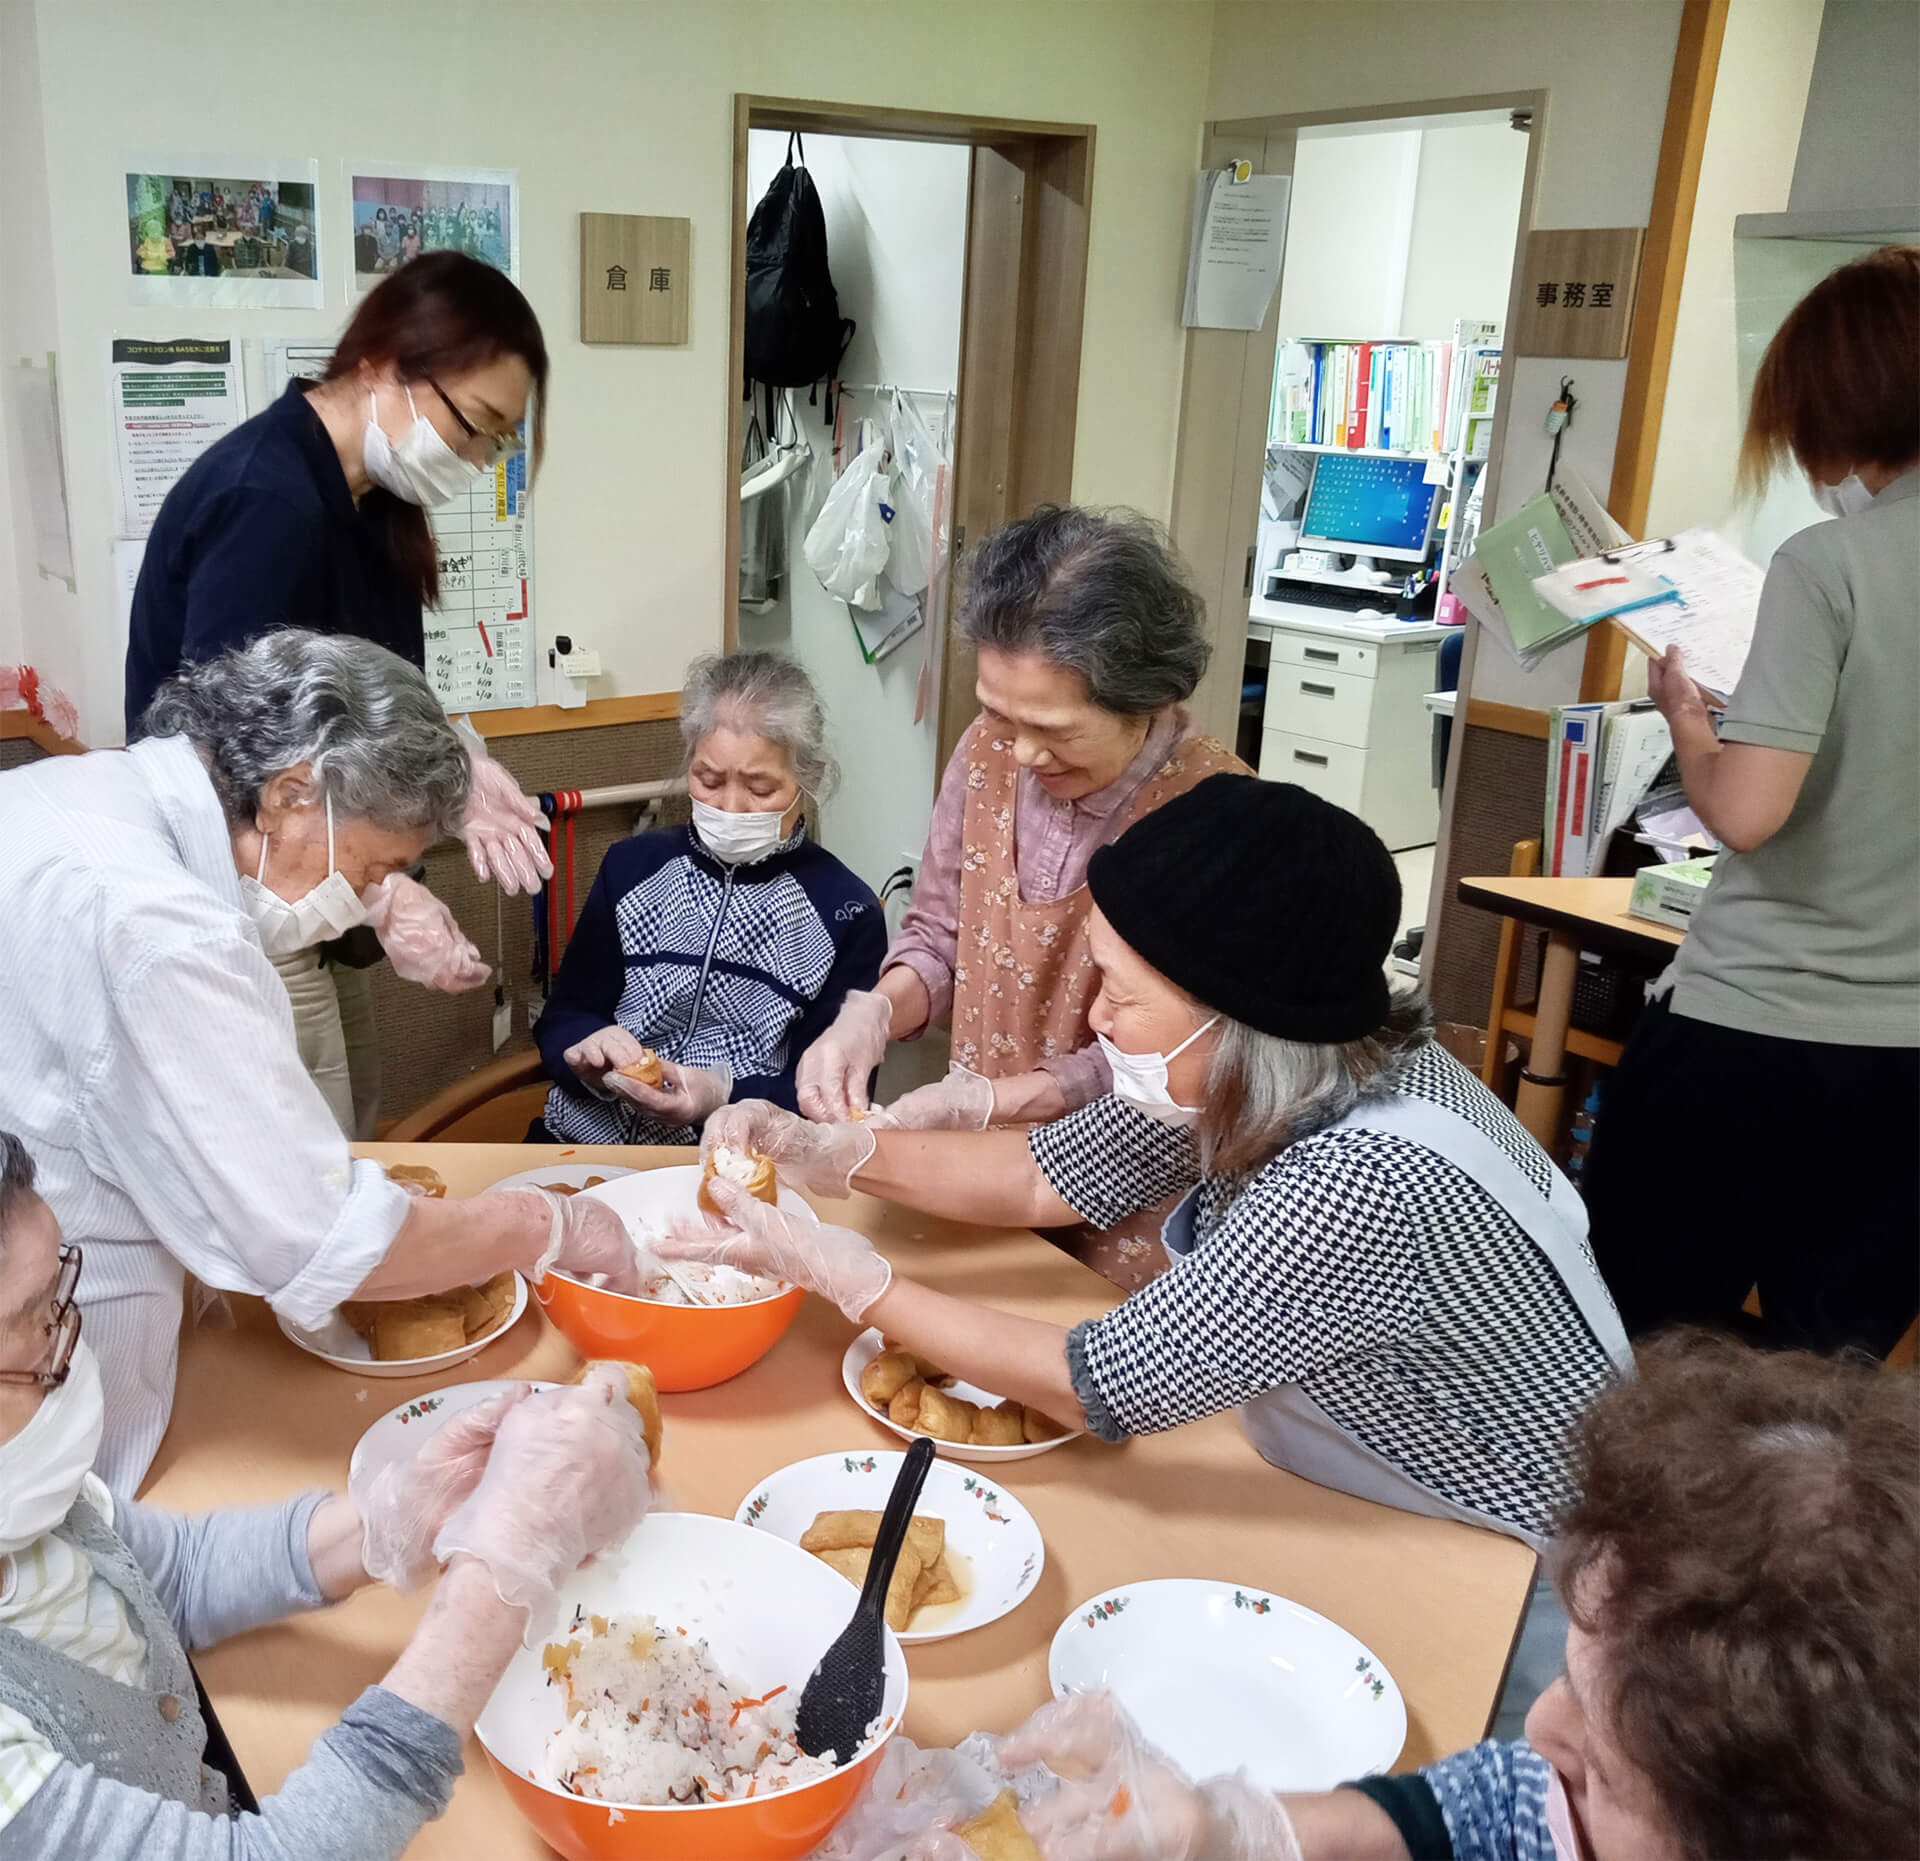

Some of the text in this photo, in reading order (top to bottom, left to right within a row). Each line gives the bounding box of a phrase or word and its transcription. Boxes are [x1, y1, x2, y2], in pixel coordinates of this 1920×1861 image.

[606, 264, 671, 293] 倉庫
[1535, 282, 1614, 308] 事務室
